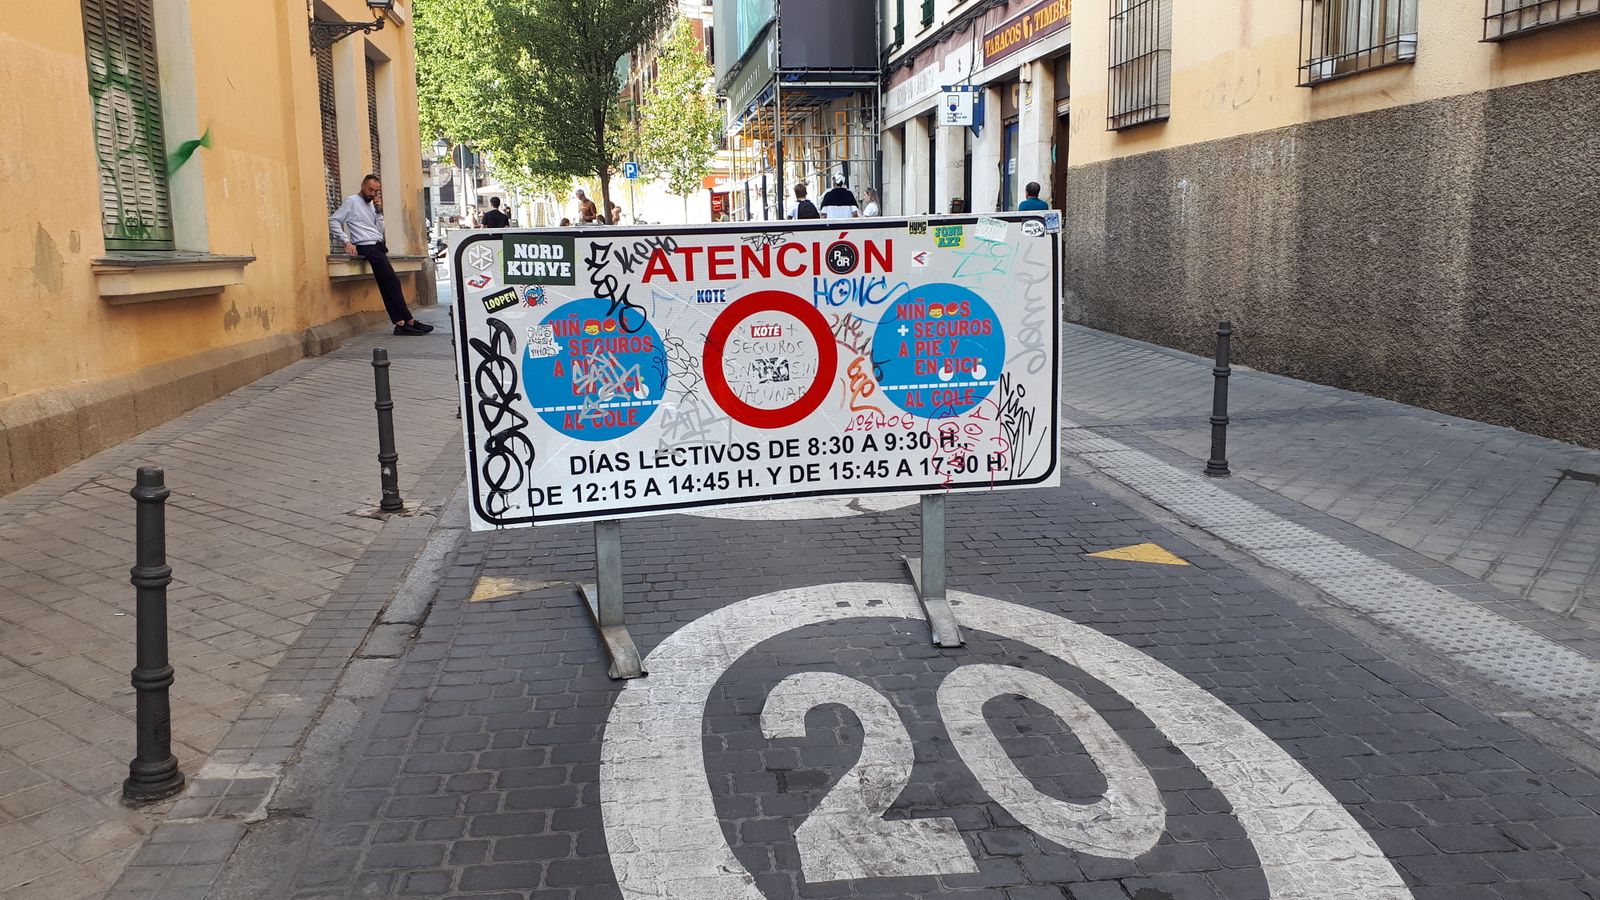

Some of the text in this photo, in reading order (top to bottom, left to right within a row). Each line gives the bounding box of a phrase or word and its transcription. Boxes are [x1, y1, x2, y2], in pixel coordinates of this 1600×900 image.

[985, 22, 1021, 58] TABACOS
[626, 163, 635, 178] P
[513, 243, 564, 259] NORD
[641, 231, 893, 283] ATENCIÓN
[507, 260, 571, 277] KURVE
[484, 290, 517, 310] LOOPEN
[697, 289, 726, 303] KOTE
[753, 326, 781, 337] KOTE
[913, 318, 992, 338] SEGUROS
[568, 335, 654, 356] SEGUROS
[730, 340, 804, 357] SEGUROS
[899, 339, 960, 357] A PIE Y
[553, 360, 565, 378] A
[915, 357, 980, 375] EN BICI
[905, 388, 976, 408] AL COLE
[563, 408, 639, 430] AL COLE
[570, 450, 630, 476] DÍAS
[639, 441, 761, 470] LECTIVOS
[769, 438, 799, 459] DE
[807, 436, 854, 457] 8:30
[861, 434, 879, 452] A
[884, 430, 933, 451] 9:30
[528, 485, 563, 507] DE
[572, 479, 637, 504] 12:15
[643, 477, 661, 497] A
[668, 471, 730, 495] 14:45
[738, 468, 760, 488] H.
[766, 466, 782, 486] Y
[790, 463, 821, 484] DE
[828, 460, 890, 480] 15:45
[896, 458, 913, 478] A
[987, 453, 1009, 472] H.
[760, 664, 1167, 883] 20
